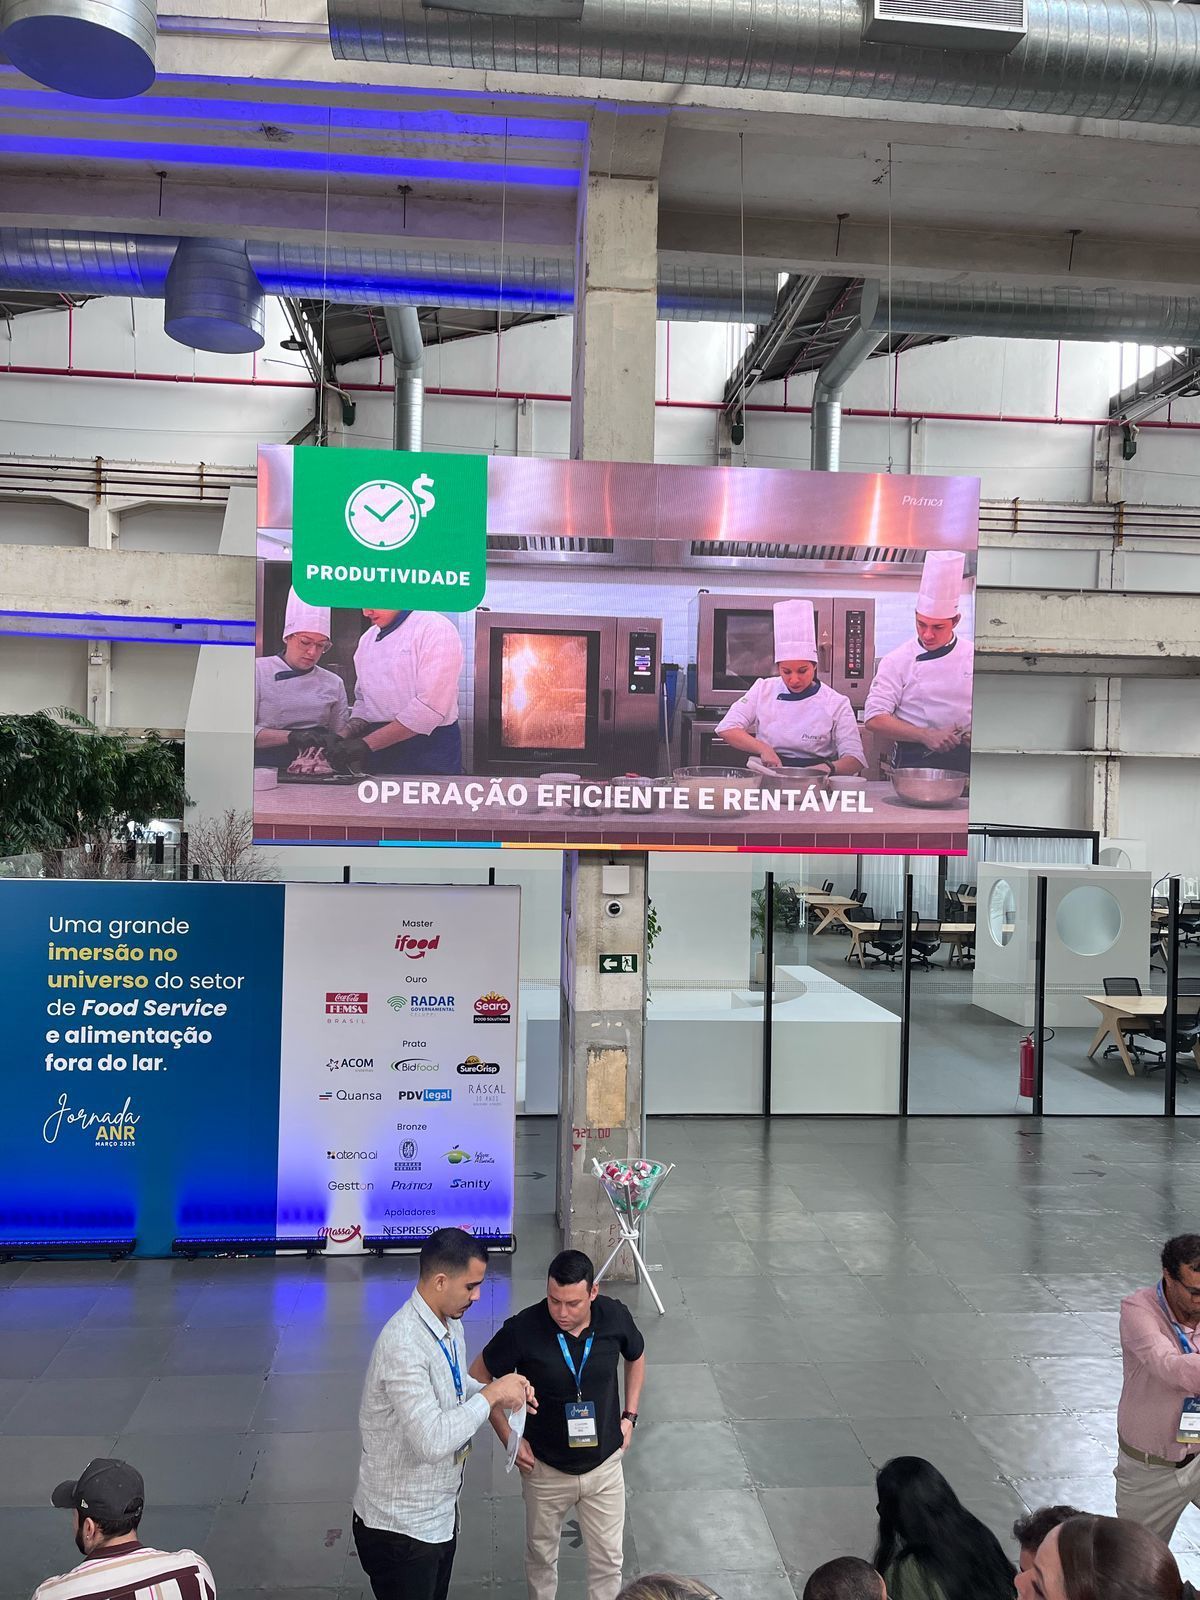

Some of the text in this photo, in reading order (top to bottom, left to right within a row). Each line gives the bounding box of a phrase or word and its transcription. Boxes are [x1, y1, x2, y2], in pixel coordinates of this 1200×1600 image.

[306, 564, 471, 587] PRODUTIVIDADE
[357, 777, 874, 813] OPERAÇÃO EFICIENTE E RENTÁVEL
[49, 916, 190, 939] Uma grande
[402, 920, 434, 928] Master
[394, 935, 441, 951] ifood
[48, 942, 178, 962] imersão no
[48, 970, 245, 989] universo do setor
[405, 975, 428, 983] Ouro
[410, 996, 455, 1006] RADAR
[475, 1001, 509, 1012] Seara
[47, 998, 228, 1017] de Food Service
[329, 1005, 364, 1013] FEMSA
[46, 1025, 213, 1049] e alimentação
[402, 1040, 427, 1048] Prata
[45, 1053, 167, 1071] fora do lar.
[341, 1058, 374, 1068] ACOM
[402, 1062, 439, 1072] Bidfood
[336, 1090, 382, 1101] Quansa
[43, 1092, 141, 1143] Jornada
[397, 1123, 427, 1131] Bronze
[96, 1126, 135, 1140] ANR
[328, 1180, 374, 1191] Gestton
[449, 1179, 491, 1191] Sanity
[384, 1208, 436, 1218] Apoiadores
[383, 1225, 440, 1235] NESPRESSO
[472, 1226, 501, 1235] VILLA
